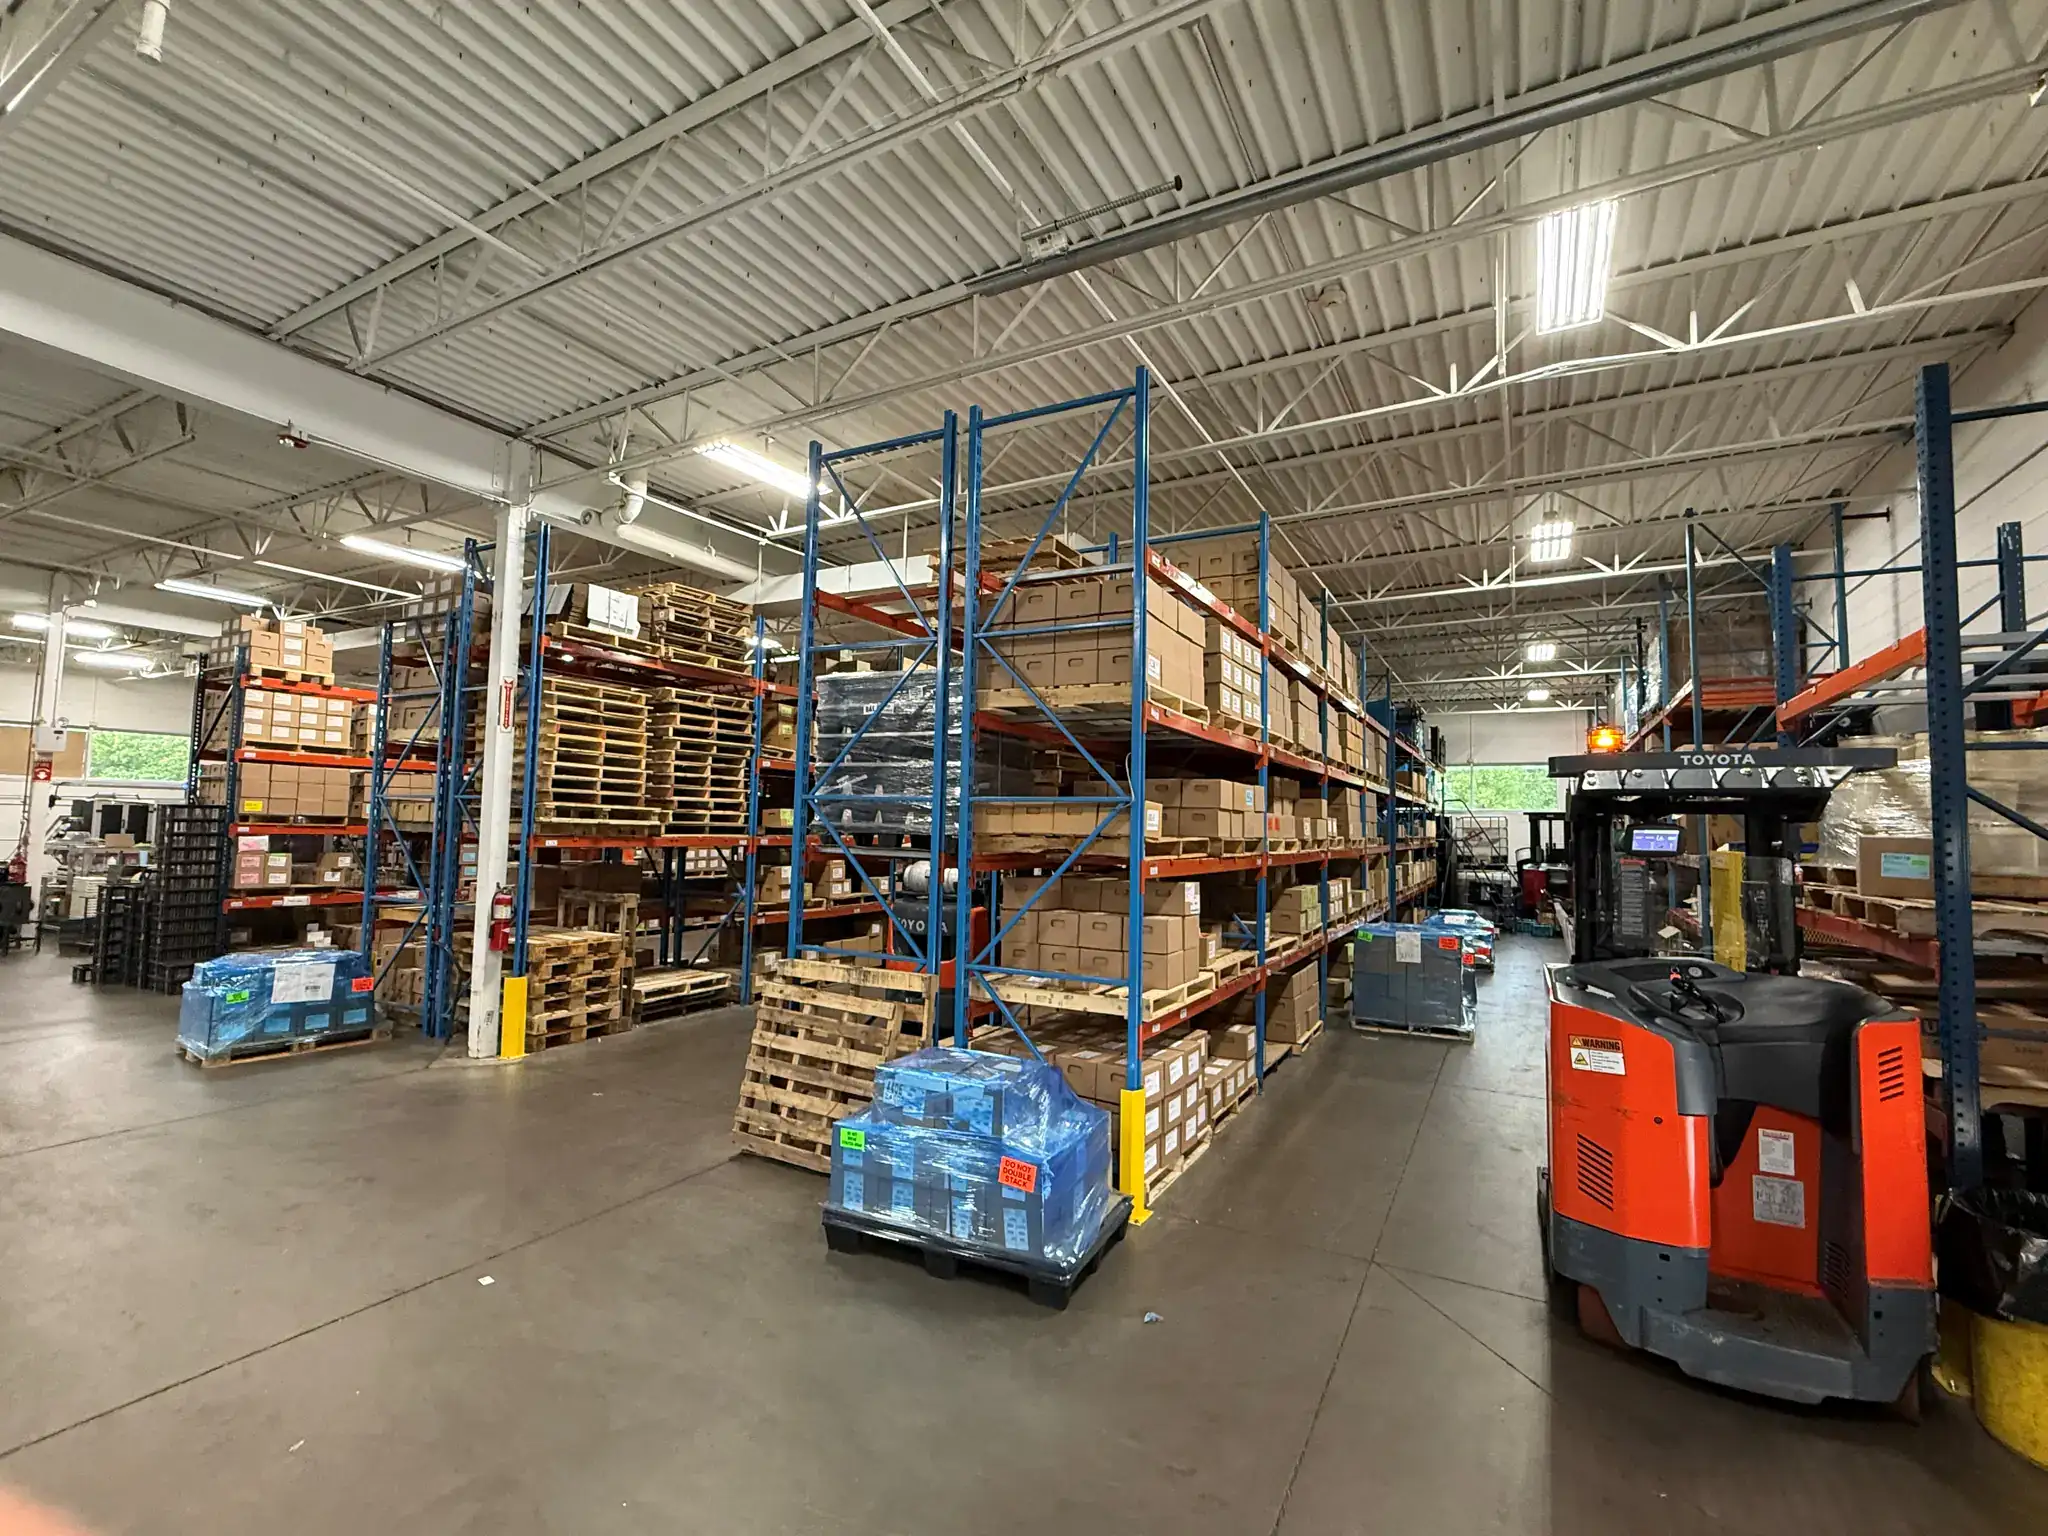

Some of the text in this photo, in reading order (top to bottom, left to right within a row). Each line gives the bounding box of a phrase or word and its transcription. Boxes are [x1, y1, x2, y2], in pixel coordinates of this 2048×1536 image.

[1680, 754, 1756, 765] TOYOTA
[897, 917, 949, 934] OYOA
[1581, 1038, 1620, 1050] WARNING
[1004, 1160, 1032, 1173] DO NOT
[1003, 1166, 1032, 1181] DOUBLE
[1004, 1175, 1028, 1187] STACK
